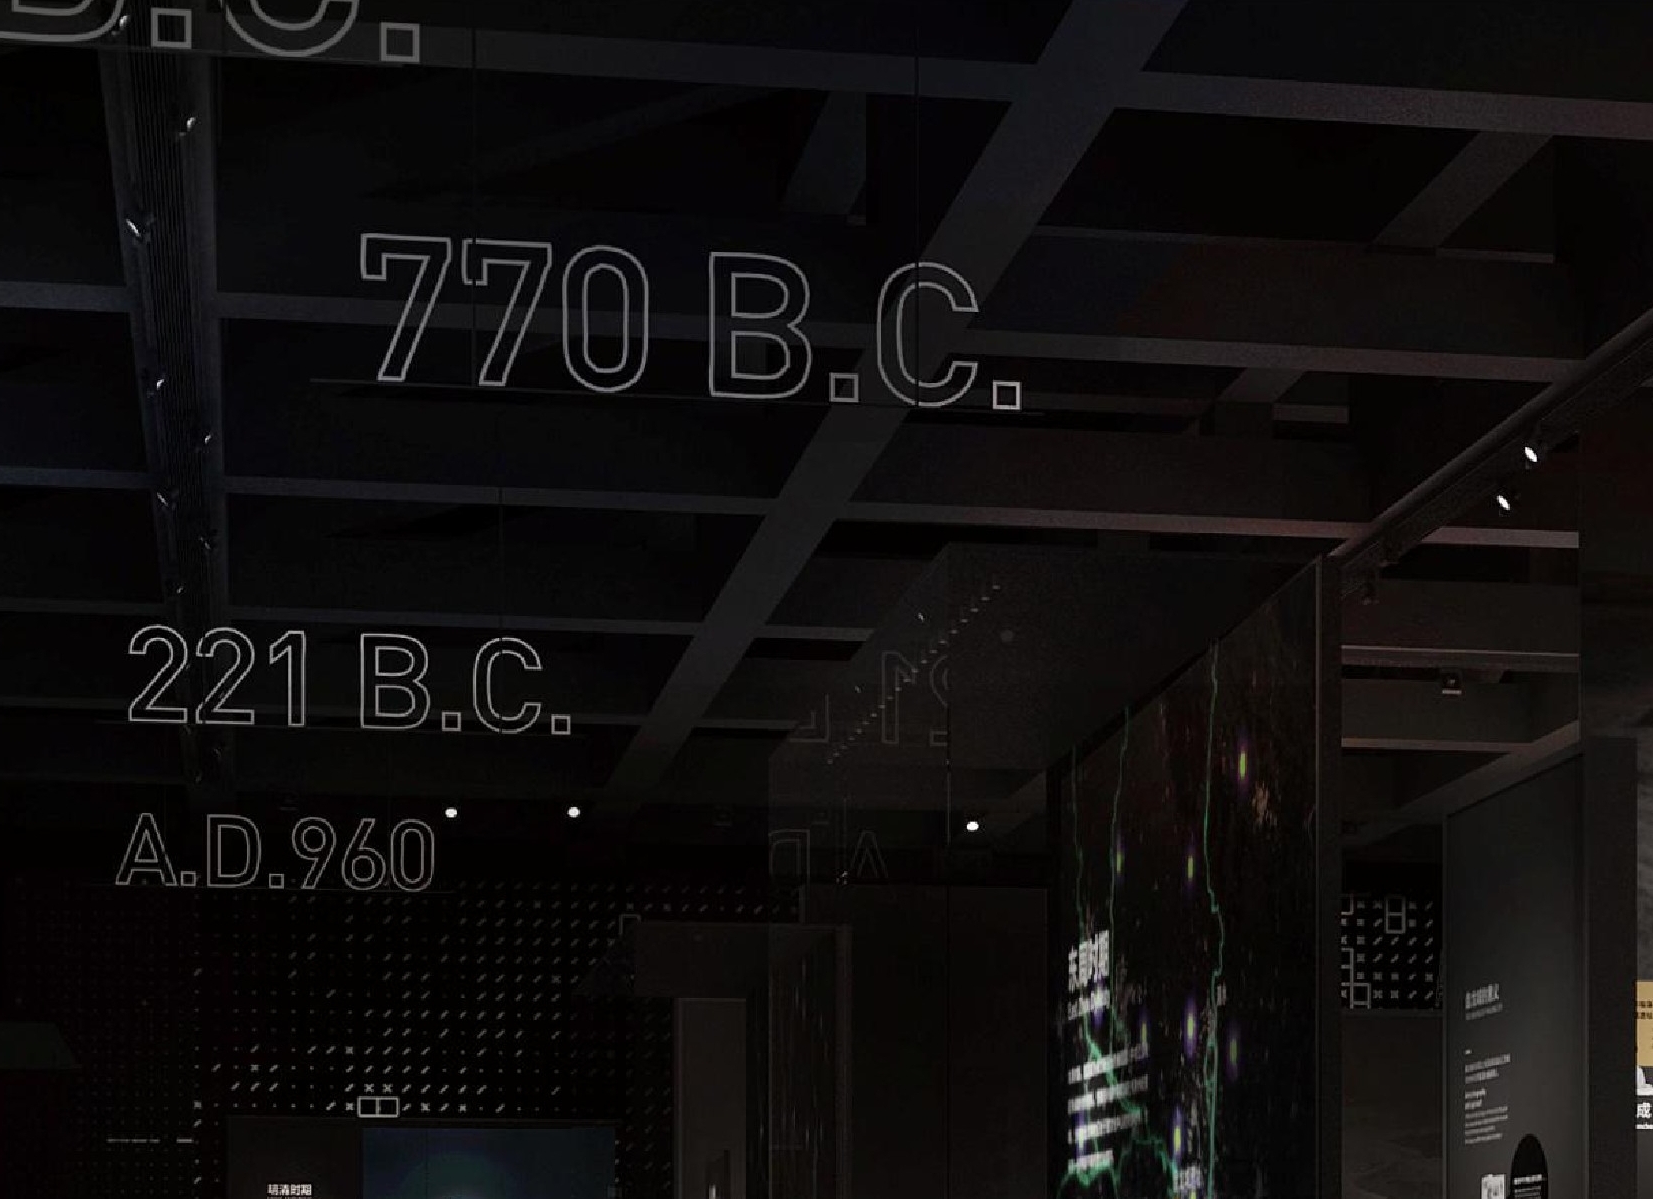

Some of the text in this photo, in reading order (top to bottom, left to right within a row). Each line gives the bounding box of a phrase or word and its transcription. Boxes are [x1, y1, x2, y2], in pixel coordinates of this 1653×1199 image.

[359, 233, 1023, 411] 770 B.C.
[127, 624, 572, 736] 221 B.C.
